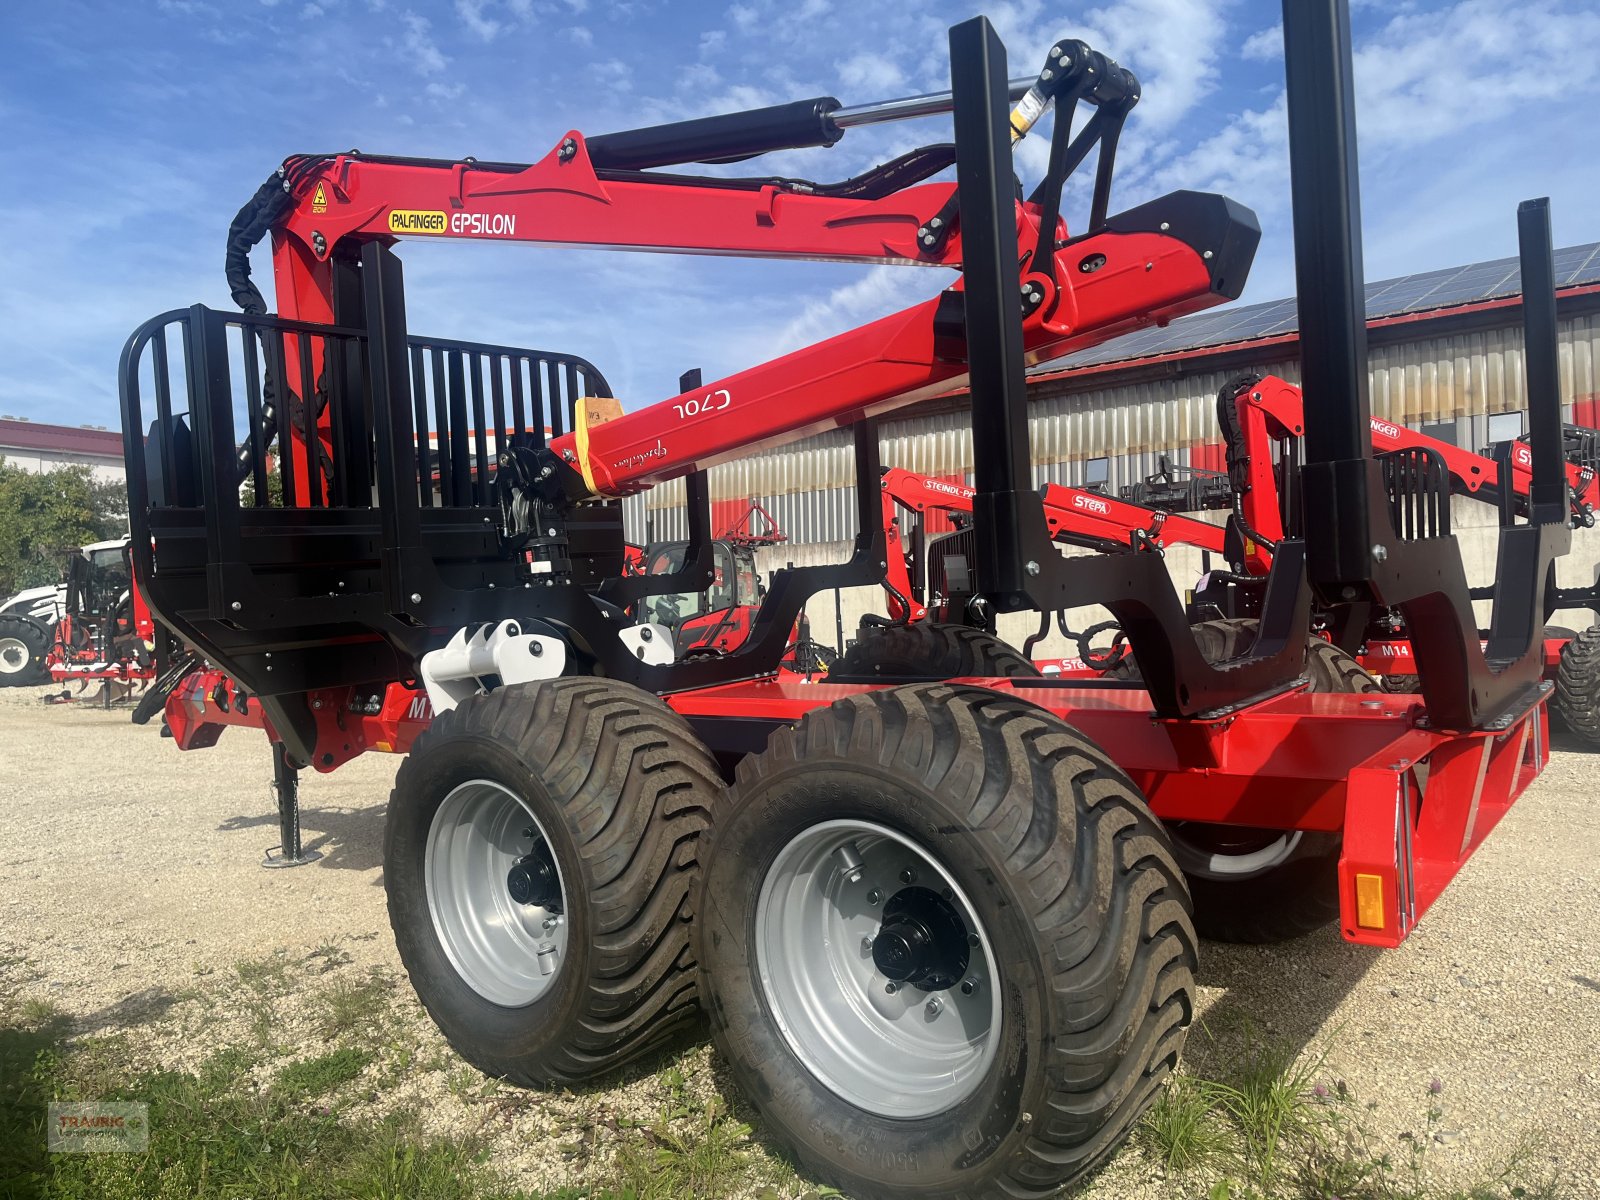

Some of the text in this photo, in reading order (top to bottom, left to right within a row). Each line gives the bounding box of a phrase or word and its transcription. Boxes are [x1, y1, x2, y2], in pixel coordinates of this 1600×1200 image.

[391, 213, 516, 235] PALFINGER EPSILON
[672, 389, 731, 419] C70L
[926, 480, 977, 498] STEINDL-PA
[1074, 495, 1108, 515] STEPA
[1382, 645, 1409, 657] M14
